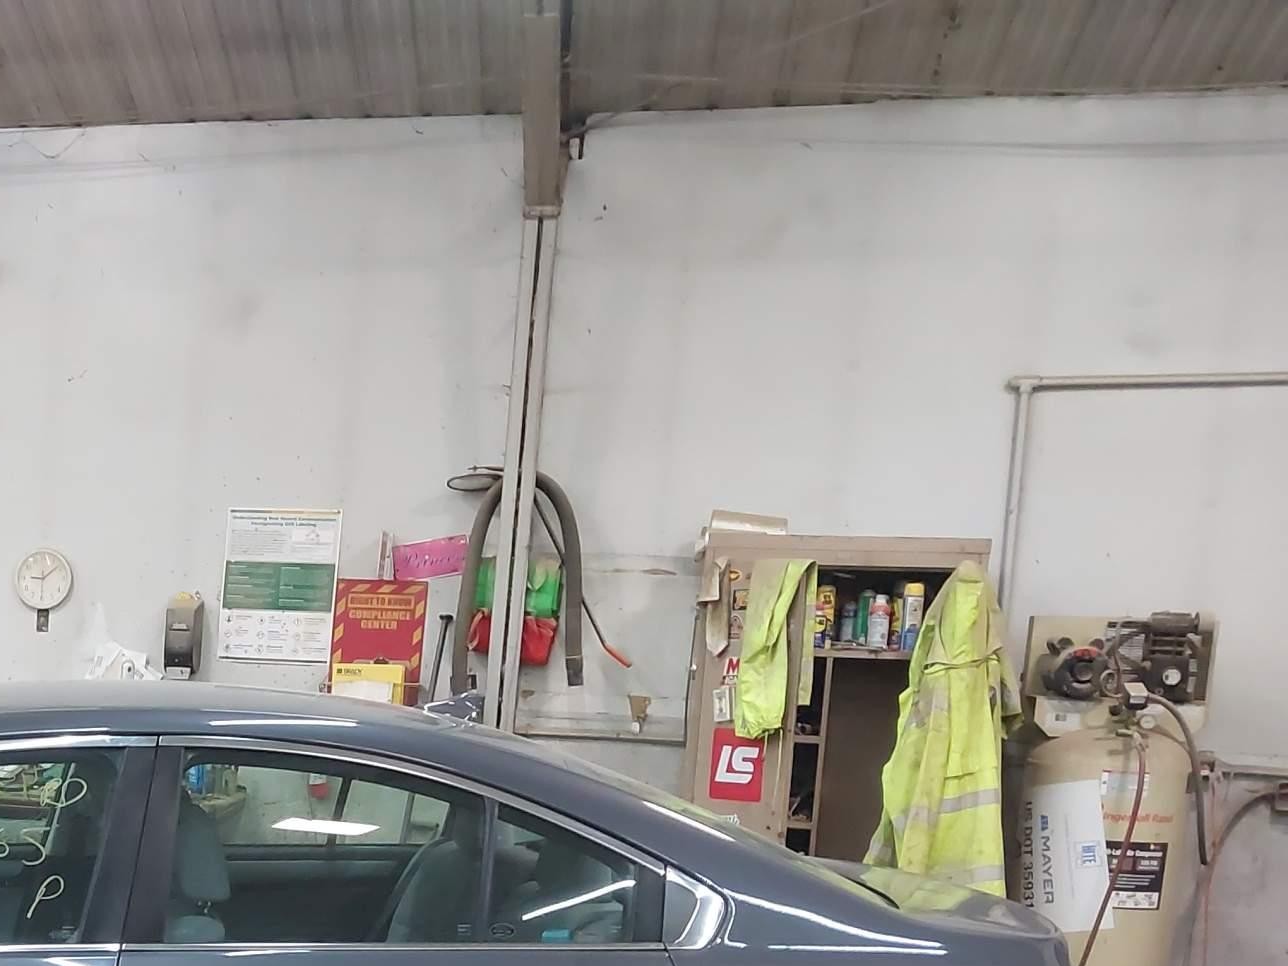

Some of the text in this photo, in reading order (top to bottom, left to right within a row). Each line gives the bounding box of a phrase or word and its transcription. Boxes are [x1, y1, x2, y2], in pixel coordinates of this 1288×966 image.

[348, 609, 411, 620] COMPLIANCE
[360, 619, 398, 630] CENTER
[714, 744, 760, 784] LS
[1023, 826, 1033, 857] DOT
[1040, 835, 1055, 904] MAYER
